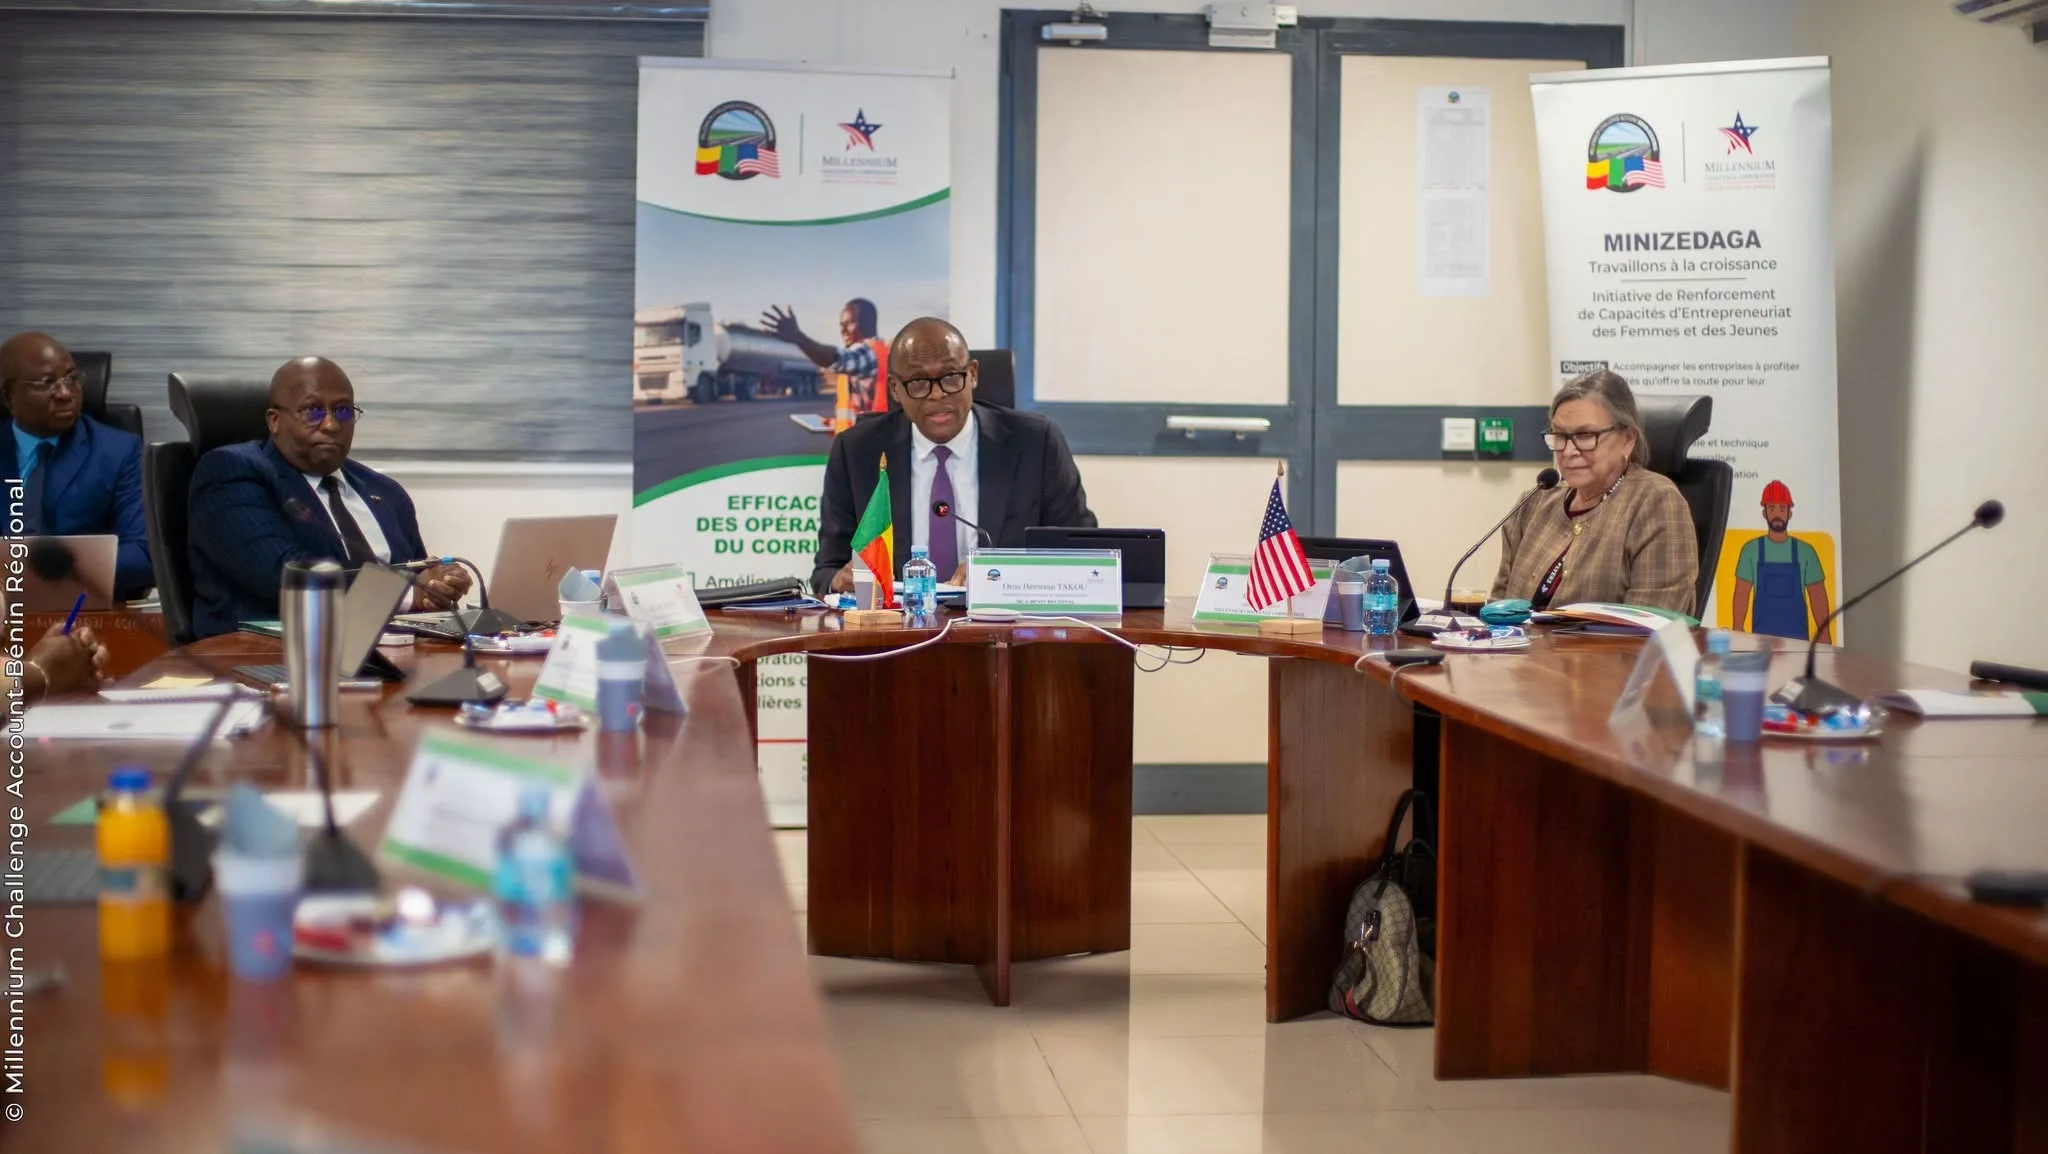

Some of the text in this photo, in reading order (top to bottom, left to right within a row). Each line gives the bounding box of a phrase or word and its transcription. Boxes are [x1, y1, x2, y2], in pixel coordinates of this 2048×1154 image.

[822, 155, 897, 168] MILLENNIUM
[1705, 160, 1775, 173] MILLENNIUM
[1604, 229, 1762, 252] MINIZEDAGA
[1588, 257, 1777, 273] Travaillons à la croissance
[1592, 288, 1776, 303] Initiative de Renforcement
[1578, 305, 1792, 323] de Capacités d'Entrepreneuriat
[1592, 324, 1778, 338] des Femmes et des Jeunes
[1613, 361, 1680, 373] Accompagner
[1682, 361, 1696, 371] les
[1698, 361, 1753, 373] entreprises
[1755, 360, 1761, 371] à
[1763, 360, 1800, 373] profiter
[1642, 376, 1680, 387] qu'offre
[1682, 376, 1691, 386] la
[1693, 377, 1719, 386] route
[1722, 377, 1744, 388] pour
[1747, 376, 1766, 386] leur
[1708, 438, 1718, 448] et
[1720, 437, 1770, 450] technique
[727, 495, 817, 511] EFFICAC
[696, 513, 819, 532] DES OPÉRA
[714, 539, 818, 554] DU CORRI
